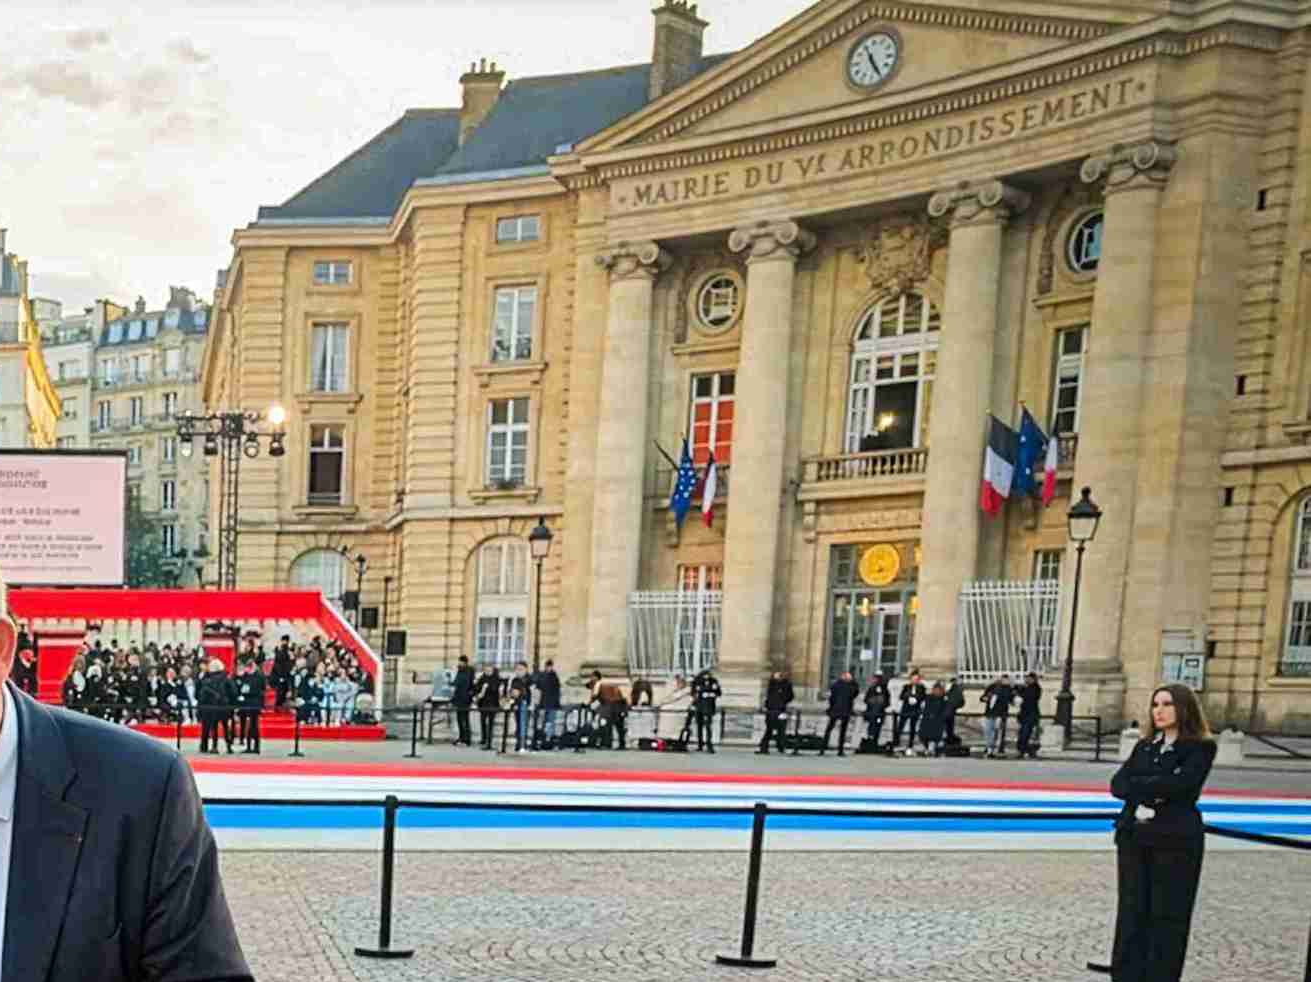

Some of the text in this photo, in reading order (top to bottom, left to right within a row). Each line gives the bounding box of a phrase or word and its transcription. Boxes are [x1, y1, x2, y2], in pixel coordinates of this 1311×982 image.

[633, 171, 731, 207] MAIRIE
[745, 161, 785, 189] DU
[839, 76, 1134, 172] ARRONDISSEMENT
